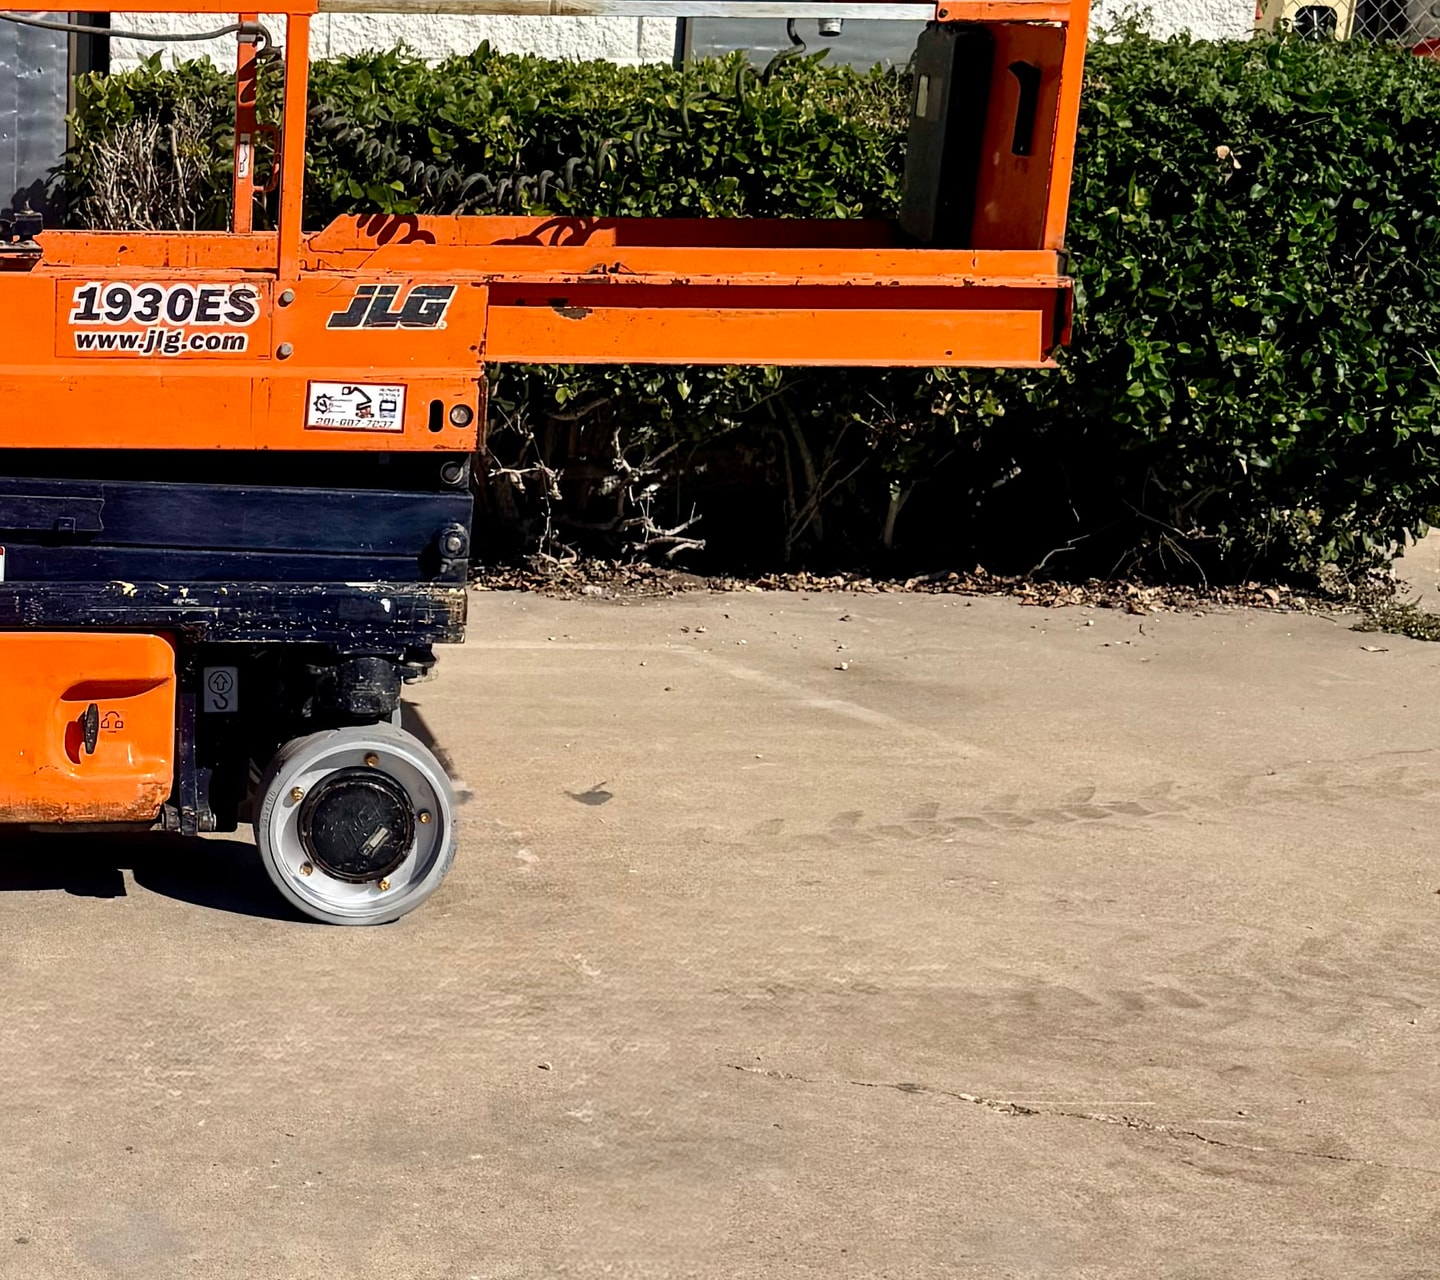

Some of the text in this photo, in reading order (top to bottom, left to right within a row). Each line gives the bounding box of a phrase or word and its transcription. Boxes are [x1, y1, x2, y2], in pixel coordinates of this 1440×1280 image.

[73, 286, 257, 323] 1930ES
[327, 284, 457, 329] JLG
[76, 330, 246, 354] www.jlg.com
